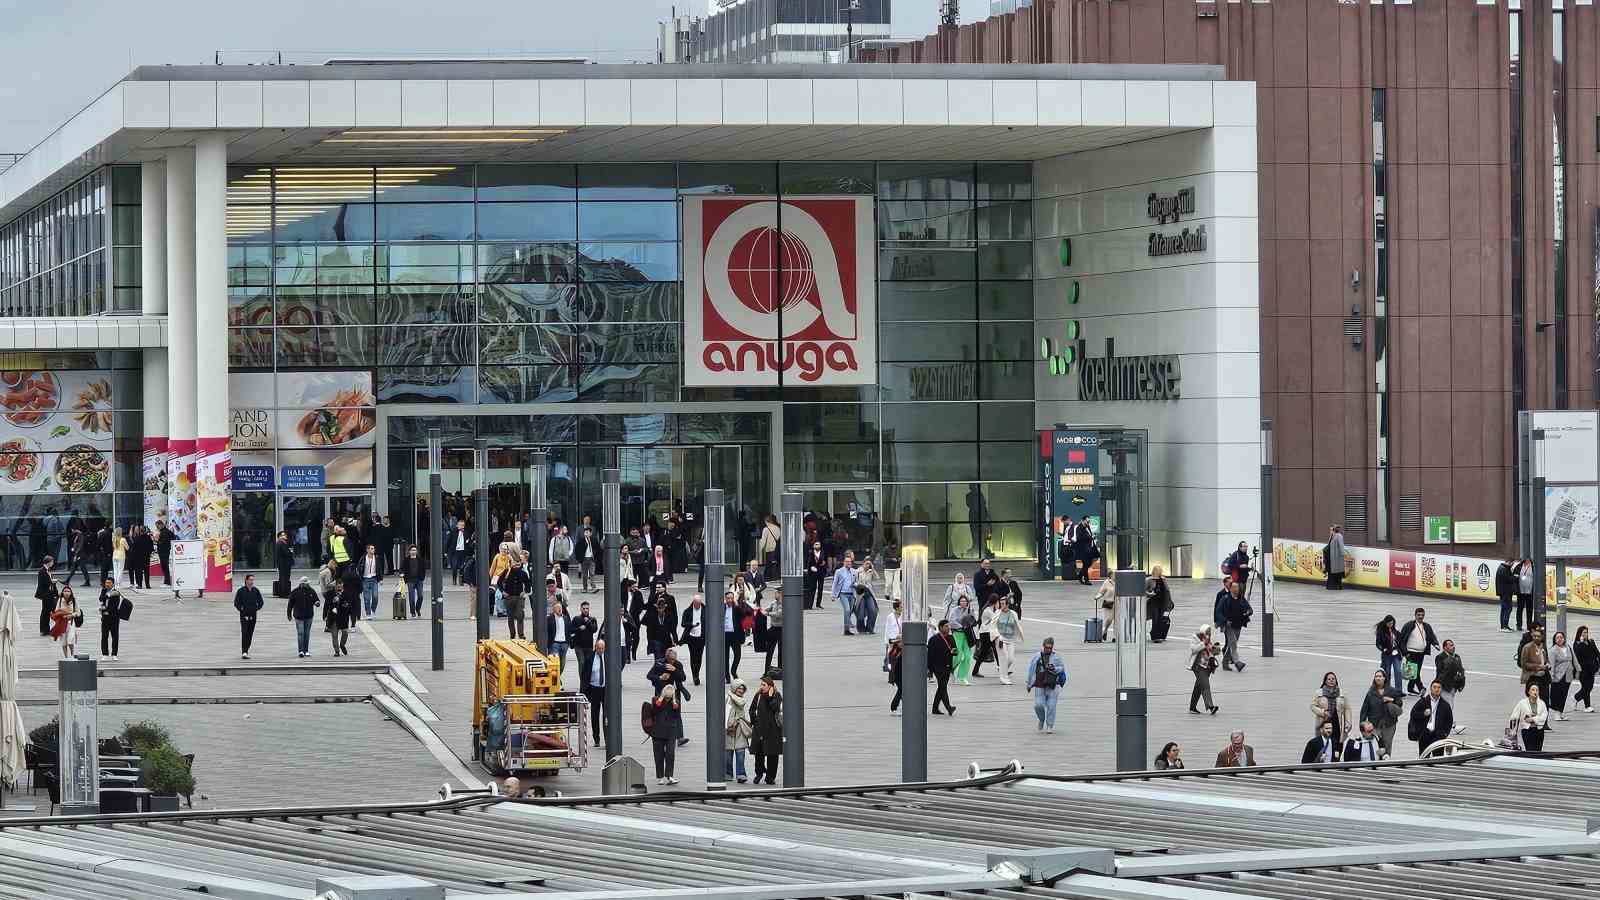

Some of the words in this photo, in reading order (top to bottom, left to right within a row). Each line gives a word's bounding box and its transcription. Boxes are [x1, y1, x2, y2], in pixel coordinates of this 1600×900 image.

[703, 341, 857, 381] anuga
[1078, 337, 1182, 400] koelnmesse
[237, 469, 256, 477] HALL
